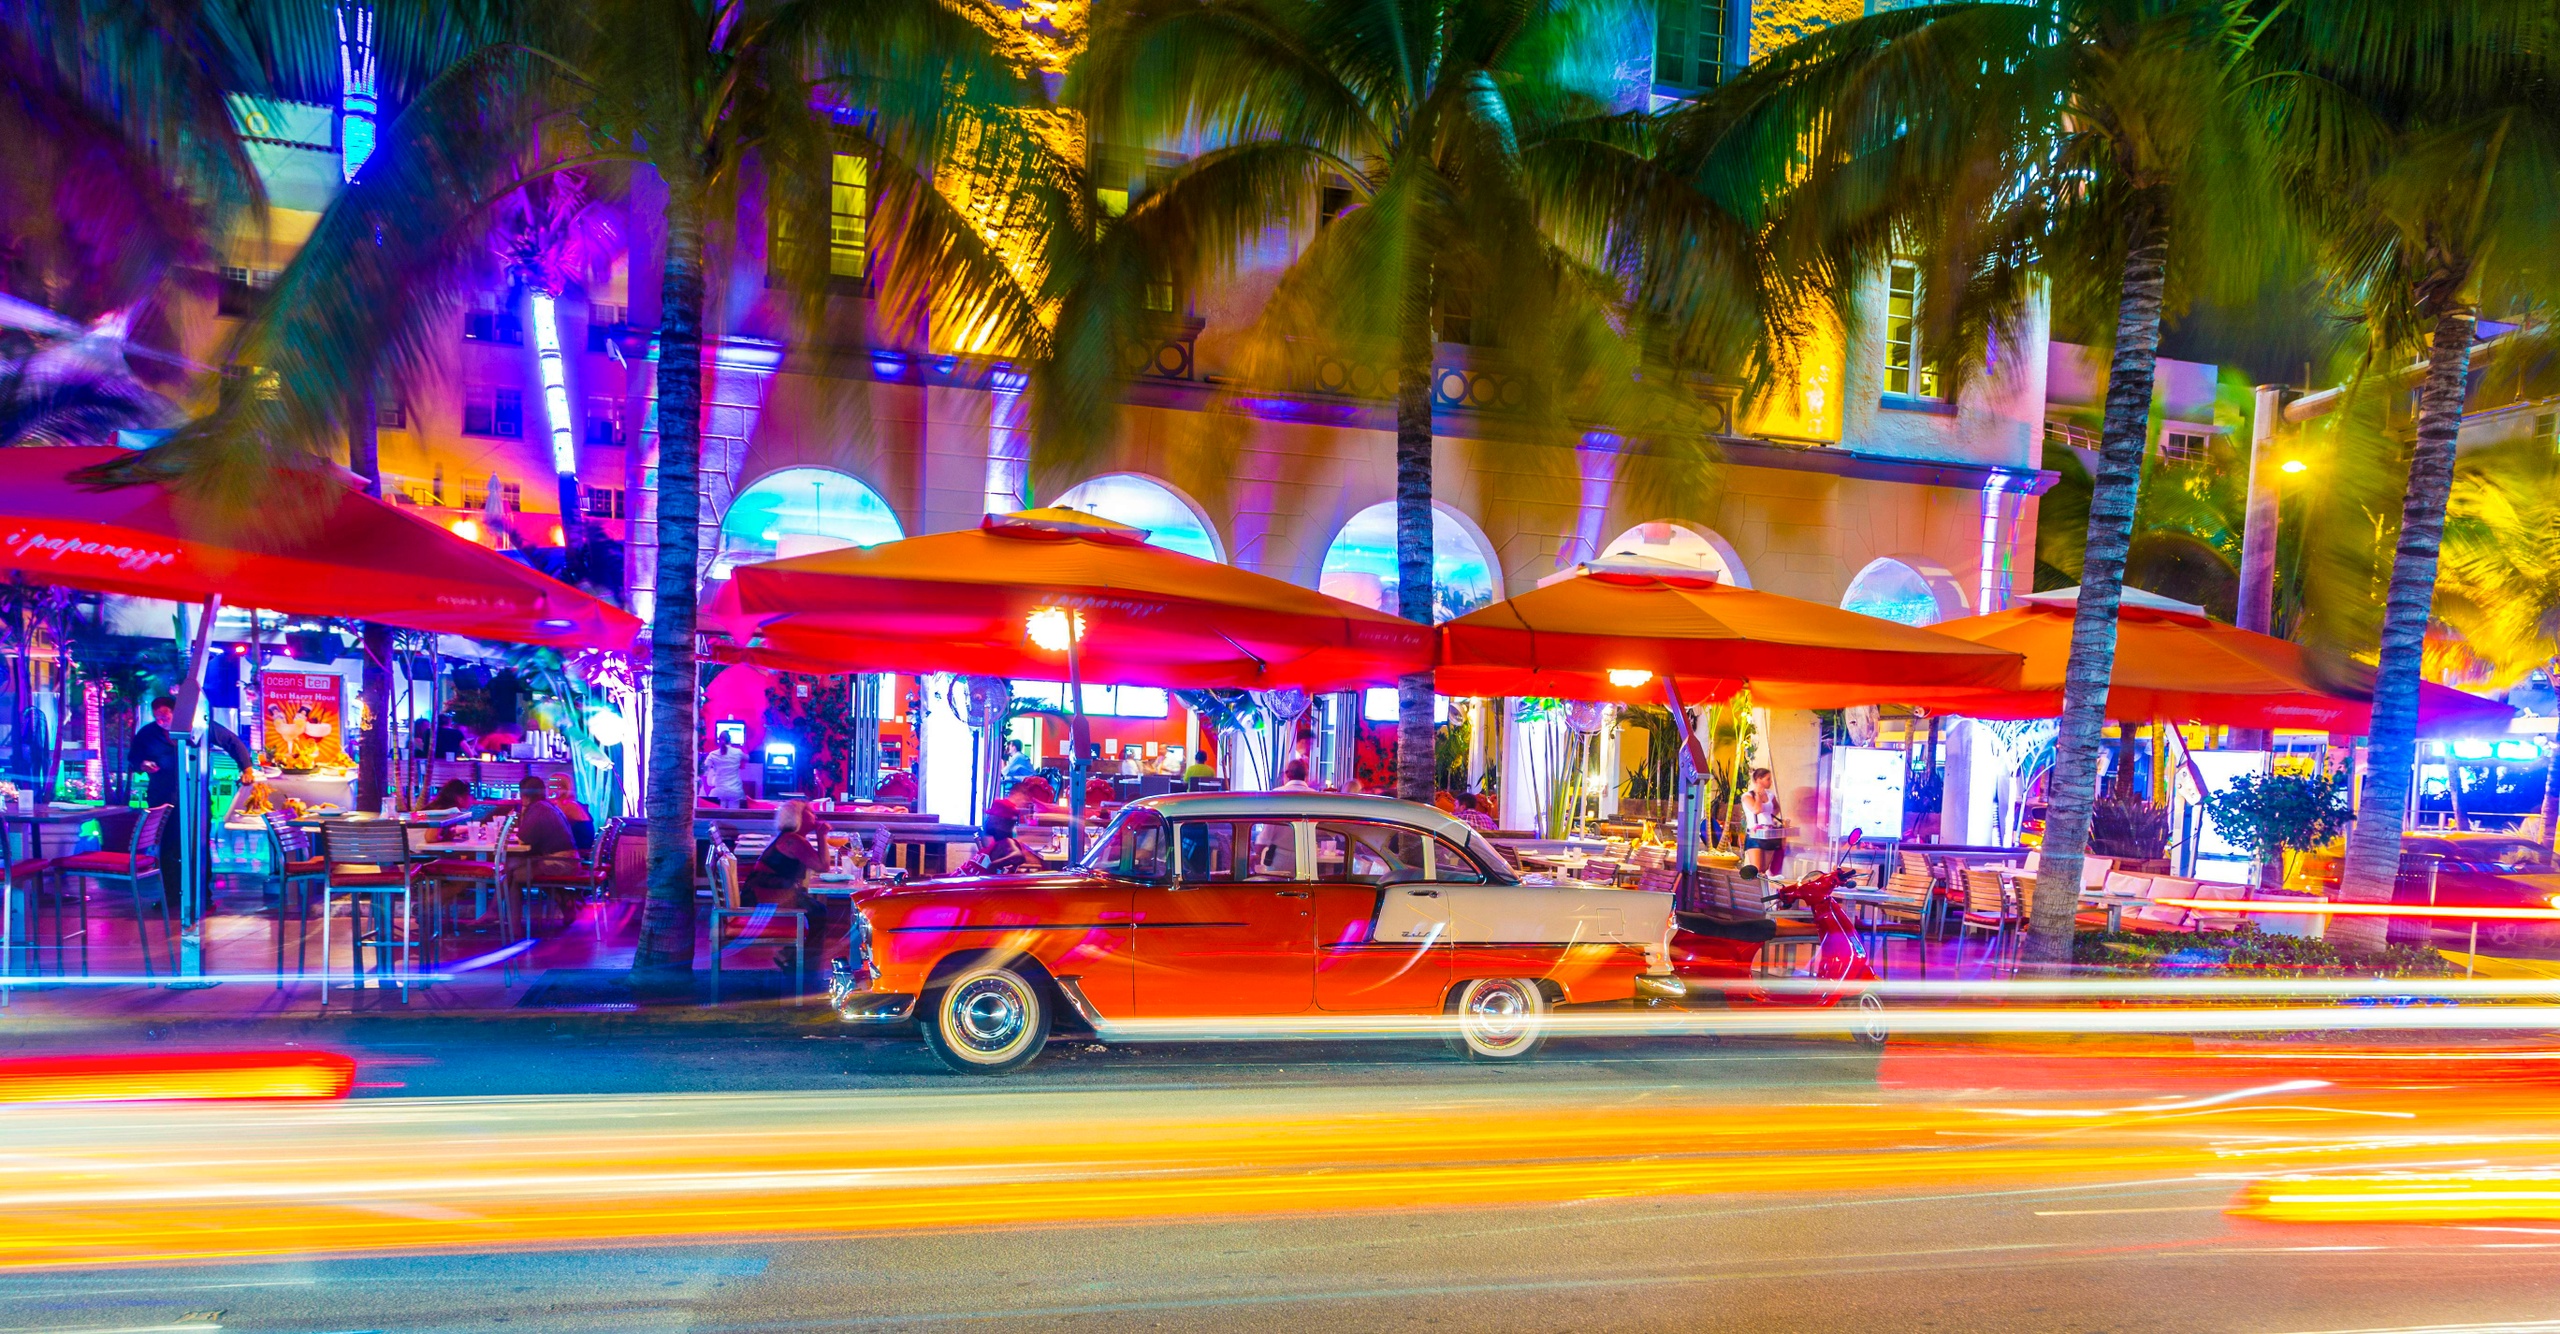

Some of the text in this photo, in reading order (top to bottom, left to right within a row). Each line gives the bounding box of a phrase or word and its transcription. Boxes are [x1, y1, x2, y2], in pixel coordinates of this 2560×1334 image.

[15, 533, 182, 571] paparazzi
[307, 677, 329, 688] ten
[270, 691, 336, 701] BEST HAPPY HOUR
